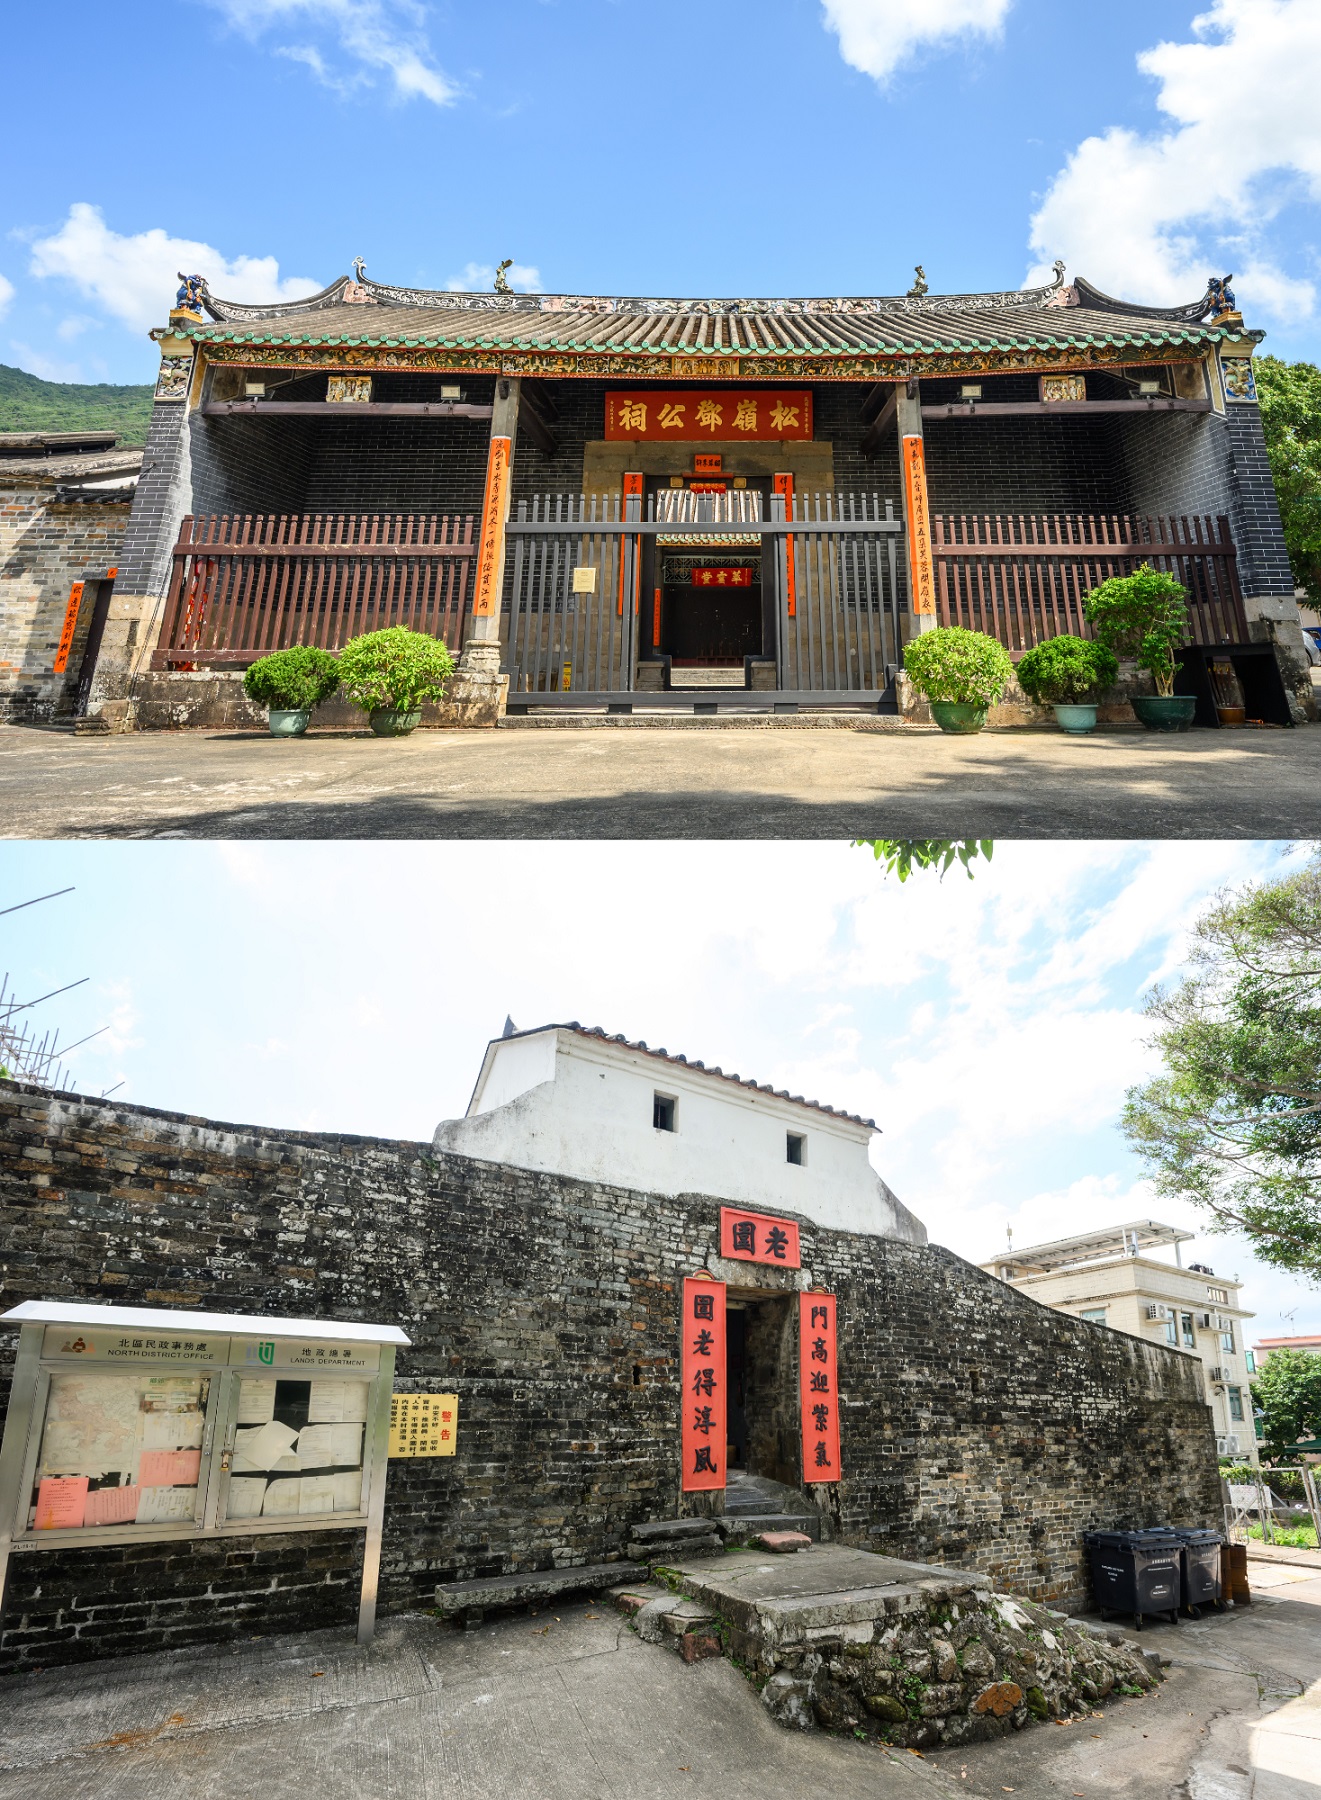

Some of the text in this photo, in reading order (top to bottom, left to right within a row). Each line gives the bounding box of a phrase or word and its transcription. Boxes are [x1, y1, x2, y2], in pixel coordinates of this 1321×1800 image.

[618, 398, 800, 433] 松嶺鄧公祠
[732, 1221, 789, 1259] 老圍
[118, 1338, 207, 1351] 北區民政事務處
[141, 1350, 181, 1358] DISTRICT
[183, 1352, 214, 1360] OFFICE
[301, 1348, 352, 1358] 地政總署
[317, 1358, 366, 1366] DEPARTMENT
[692, 1294, 718, 1475] 圍老得淳風
[810, 1305, 831, 1468] 門高迎紫氣
[440, 1410, 452, 1440] 警告
